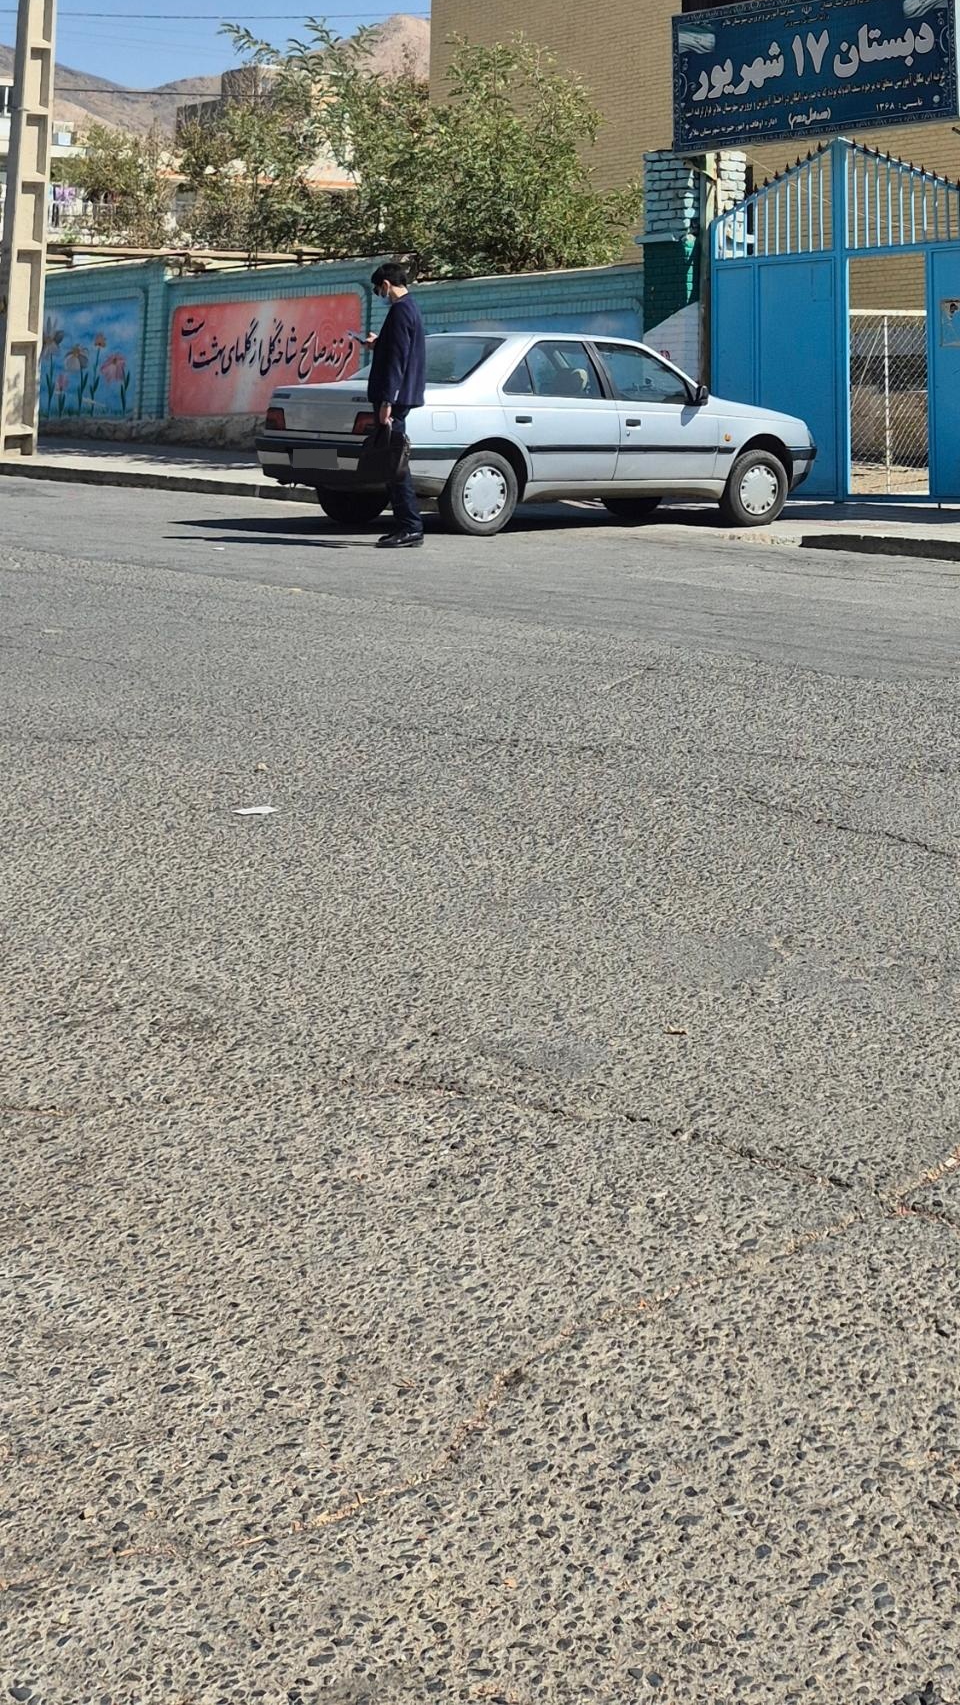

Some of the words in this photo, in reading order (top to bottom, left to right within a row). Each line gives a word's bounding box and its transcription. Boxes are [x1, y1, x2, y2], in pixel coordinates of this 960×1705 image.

[692, 41, 784, 101] شهریور
[792, 29, 830, 77] ۱۷
[833, 22, 935, 78] دبستان
[875, 101, 895, 112] ۱۳۶۸
[181, 317, 205, 365] است
[192, 336, 225, 376] بهشت
[220, 317, 260, 374] گلهای
[249, 338, 263, 365] از
[260, 318, 284, 376] گلی
[272, 326, 298, 364] شاخه
[298, 331, 327, 379] صالح
